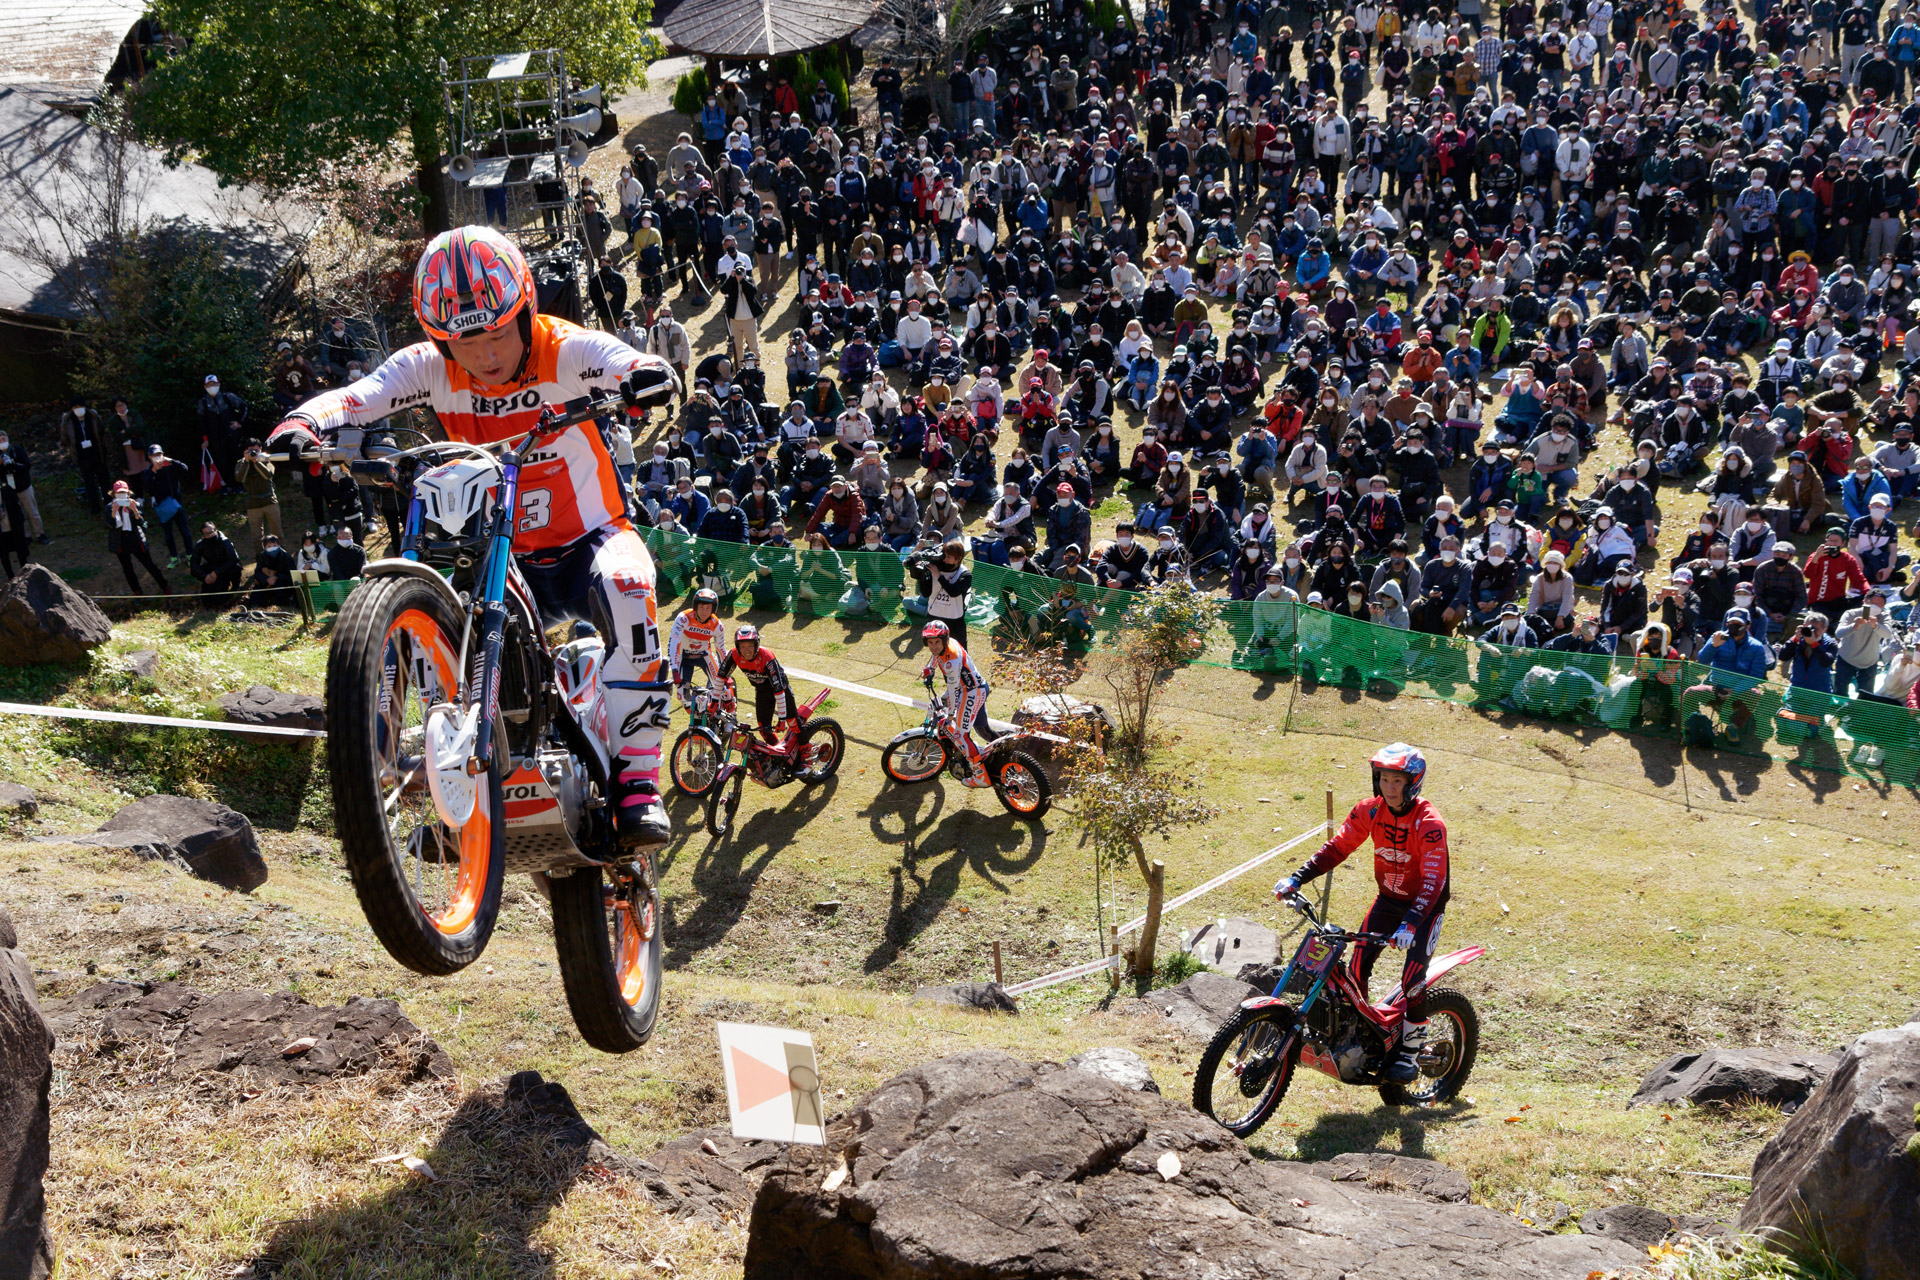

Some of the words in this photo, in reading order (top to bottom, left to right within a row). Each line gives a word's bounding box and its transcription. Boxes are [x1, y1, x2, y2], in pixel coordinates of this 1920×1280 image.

[453, 312, 488, 329] SHOEI
[471, 390, 541, 415] REPSO
[519, 488, 552, 533] 3
[689, 626, 711, 635] REPSOL
[962, 695, 976, 730] REPSOL
[503, 785, 540, 799] SOL
[1307, 943, 1330, 961] 3
[1342, 982, 1360, 1006] HONDA
